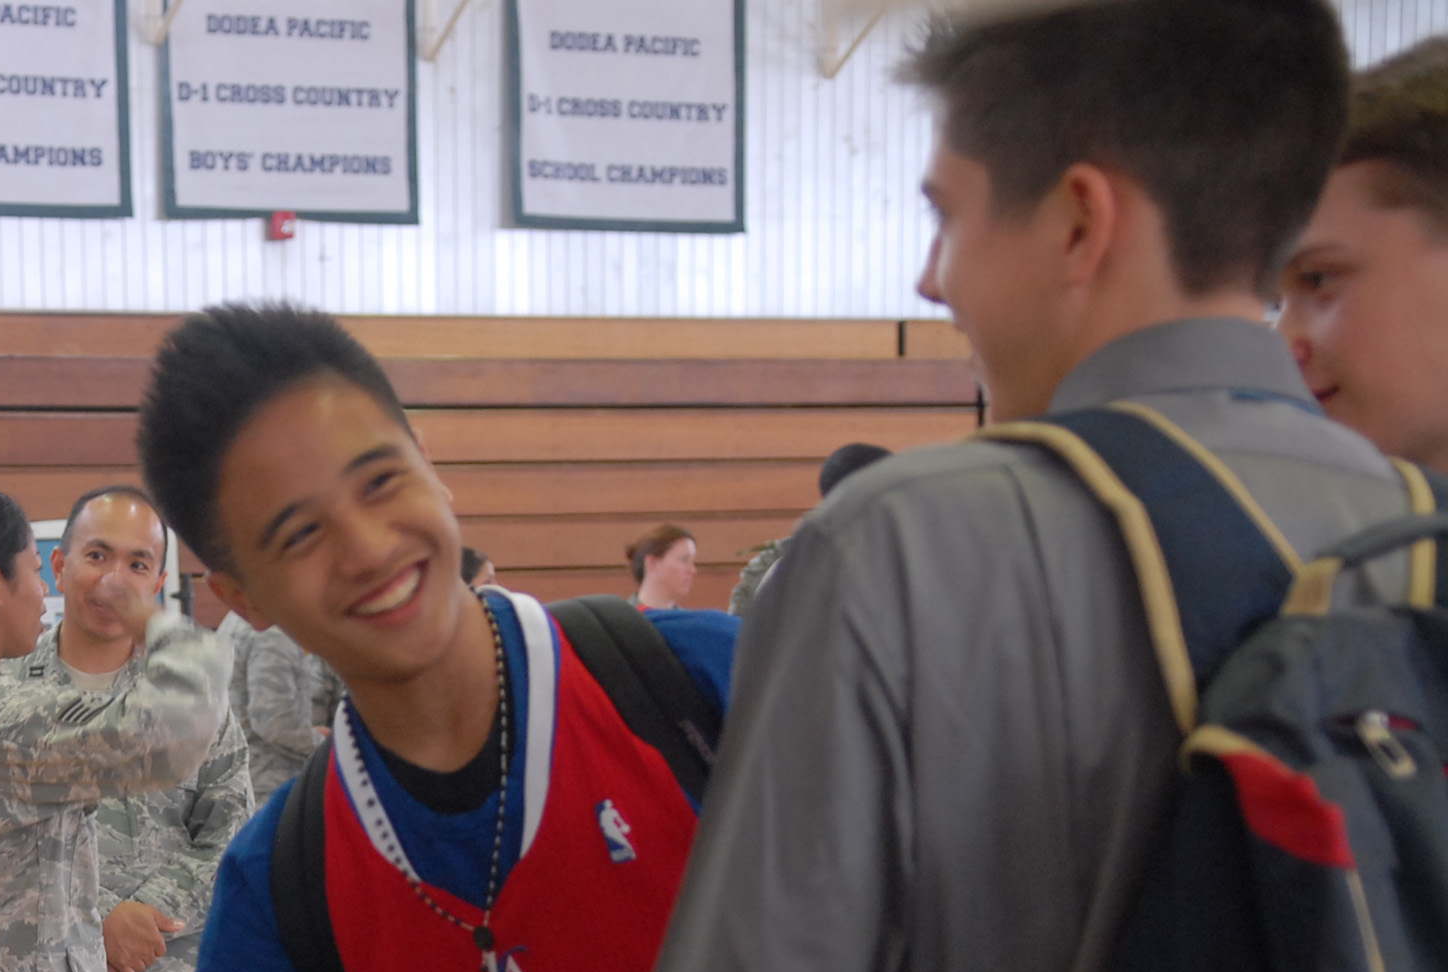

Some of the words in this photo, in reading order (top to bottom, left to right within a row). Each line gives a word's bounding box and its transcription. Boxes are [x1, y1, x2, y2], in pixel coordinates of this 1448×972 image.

[206, 14, 279, 36] DODEA
[287, 17, 371, 40] PACIFIC
[549, 30, 617, 53] DODEA
[623, 34, 700, 57] PACIFIC
[177, 82, 209, 102] D-1
[215, 83, 285, 105] CROSS
[292, 86, 400, 109] COUNTRY
[556, 96, 622, 118] CROSS
[628, 99, 727, 122] COUNTRY
[189, 150, 255, 171] BOYS'
[261, 152, 392, 176] CHAMPIONS
[527, 159, 601, 182] SCHOOL
[605, 163, 727, 186] CHAMPIONS
